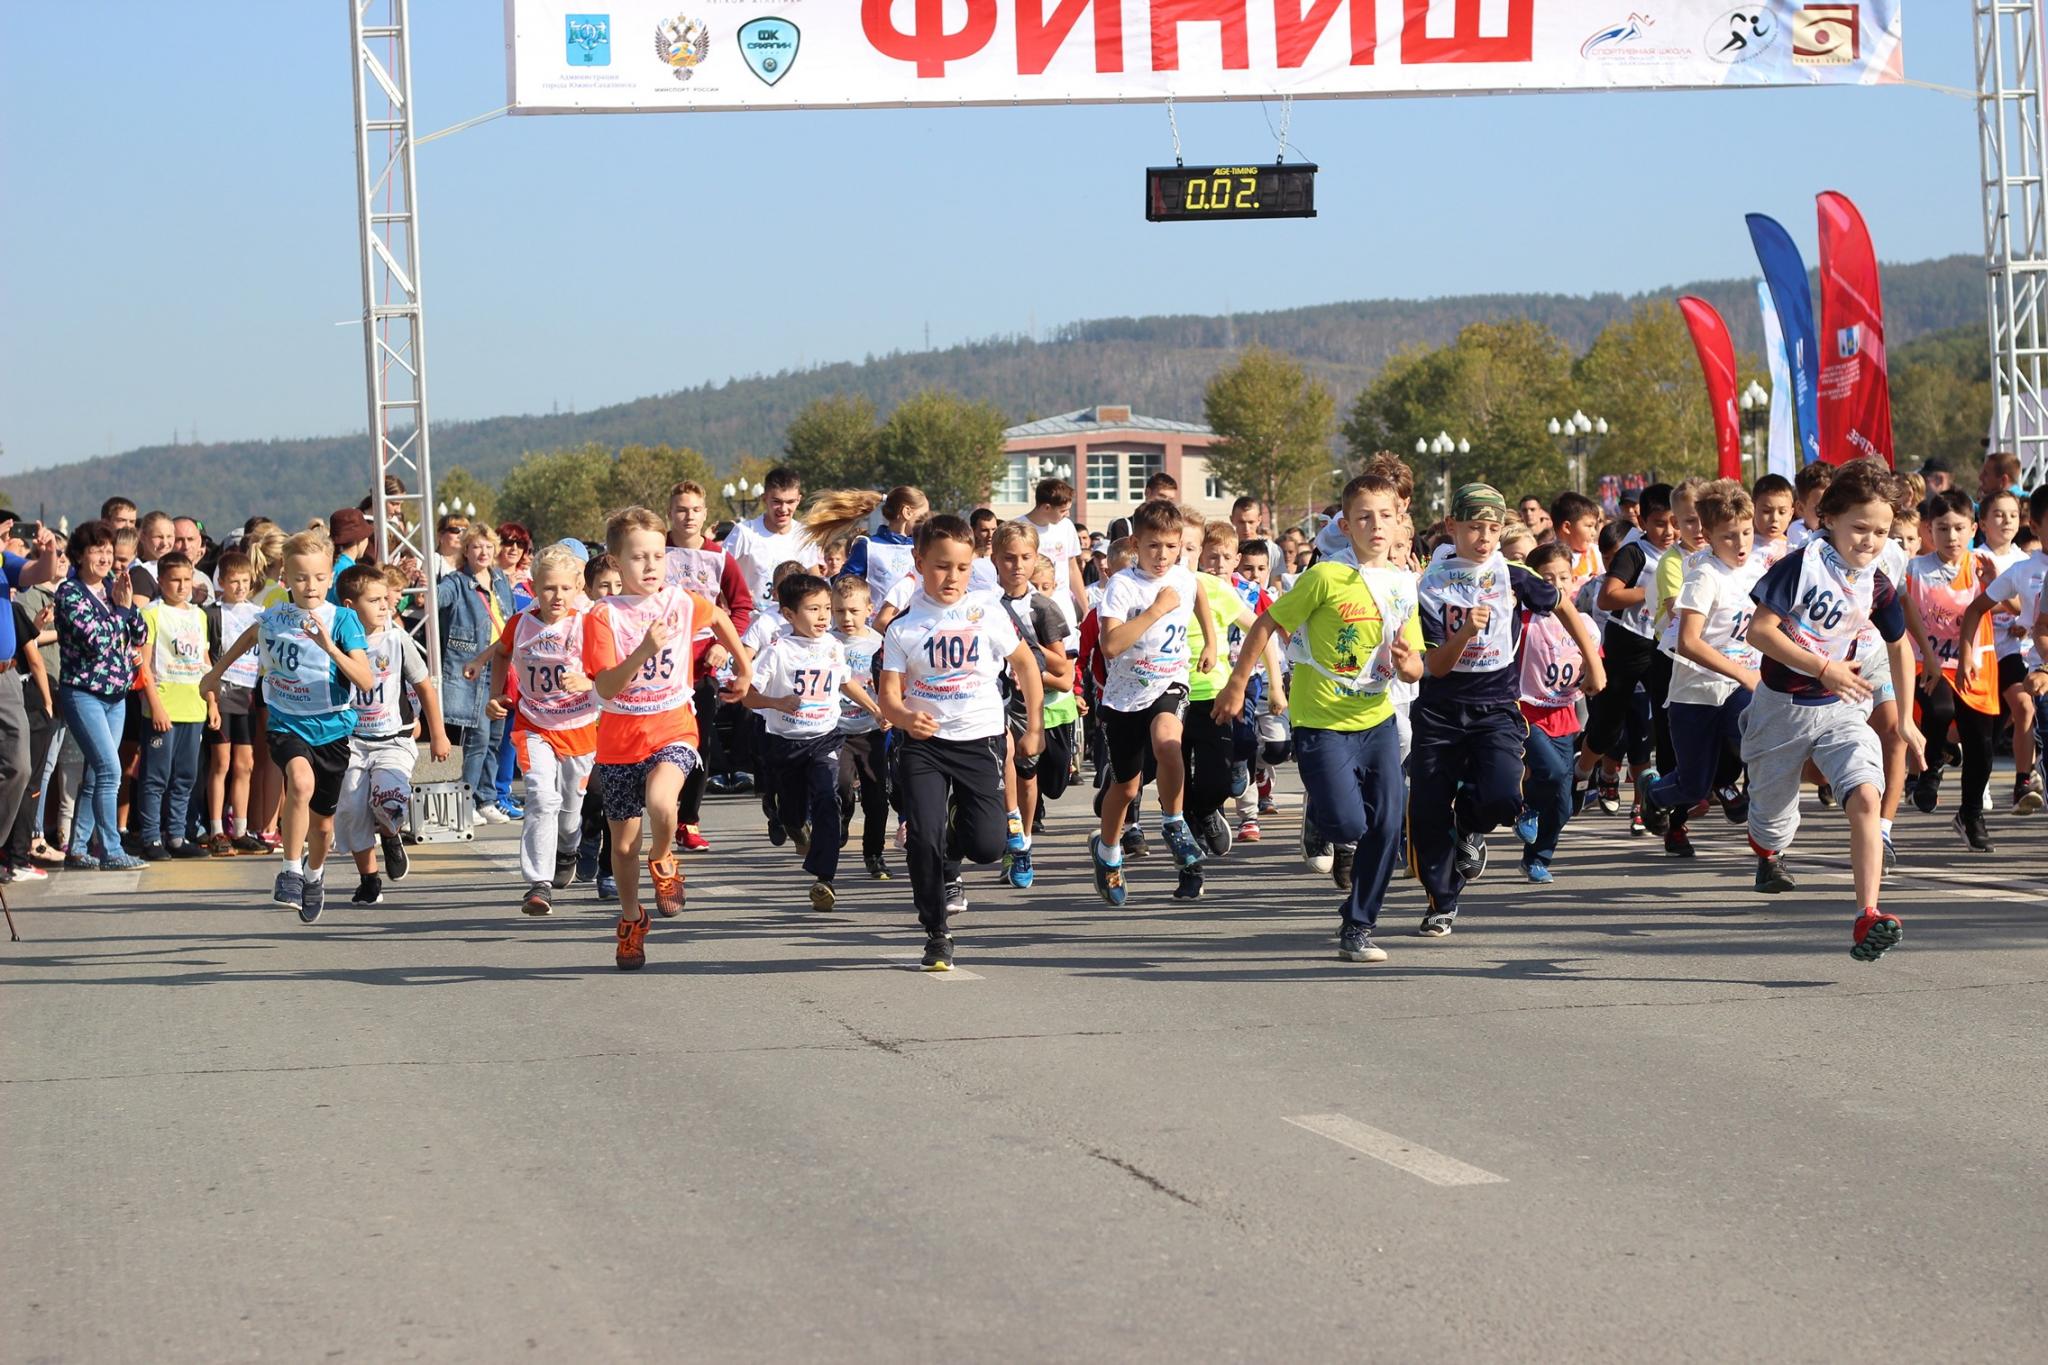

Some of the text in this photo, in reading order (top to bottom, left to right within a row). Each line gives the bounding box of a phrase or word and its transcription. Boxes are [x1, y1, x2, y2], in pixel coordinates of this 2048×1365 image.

[1803, 585, 1843, 630] 466
[265, 639, 299, 672] 718
[631, 648, 674, 682] 95
[923, 636, 980, 668] 1104
[793, 670, 832, 696] 574
